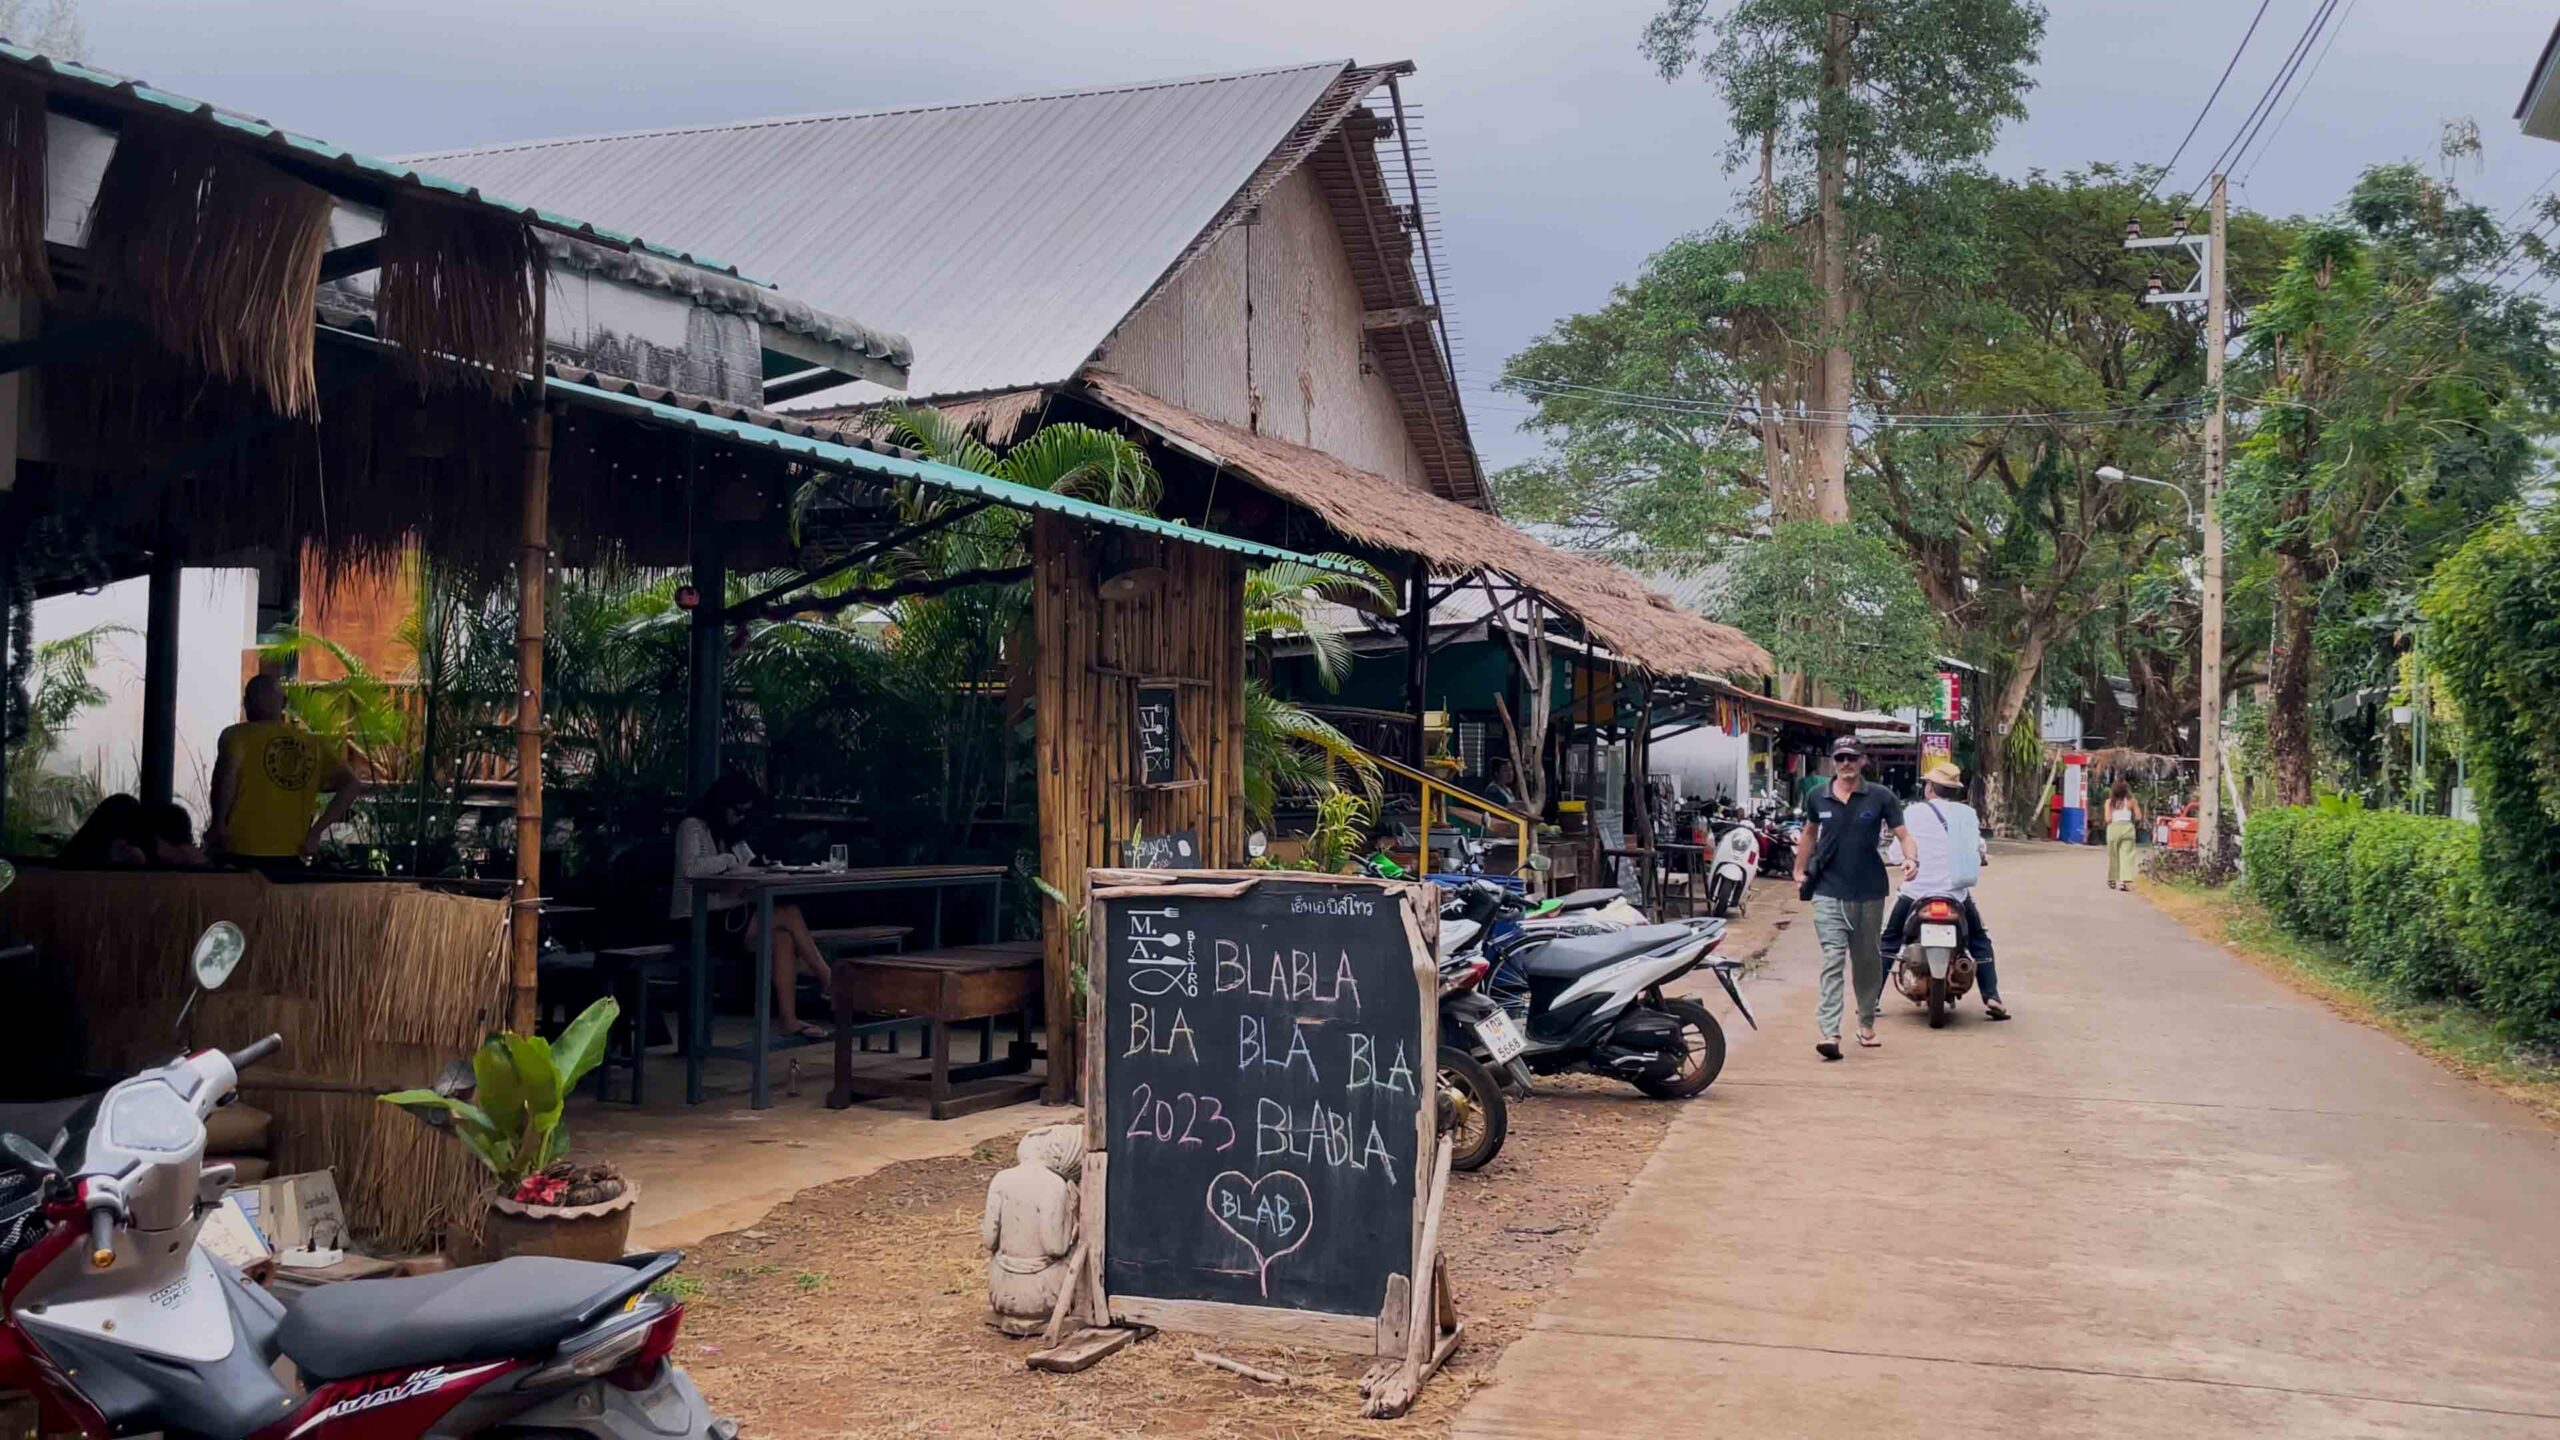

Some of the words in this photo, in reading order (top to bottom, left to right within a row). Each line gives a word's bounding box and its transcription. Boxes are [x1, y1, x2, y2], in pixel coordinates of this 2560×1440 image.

[1130, 916, 1157, 935] M.
[1130, 940, 1157, 959] A.
[1187, 930, 1198, 997] BISTRO
[1213, 939, 1361, 1009] BLABLA
[1123, 1003, 1199, 1064] BLA
[1239, 1015, 1319, 1083] BLA
[1346, 1033, 1416, 1096] BLA
[1127, 1083, 1236, 1152] 2023
[1257, 1097, 1398, 1185] BLABLA
[1221, 1189, 1296, 1237] BLAB
[335, 1373, 448, 1416] WAVE
